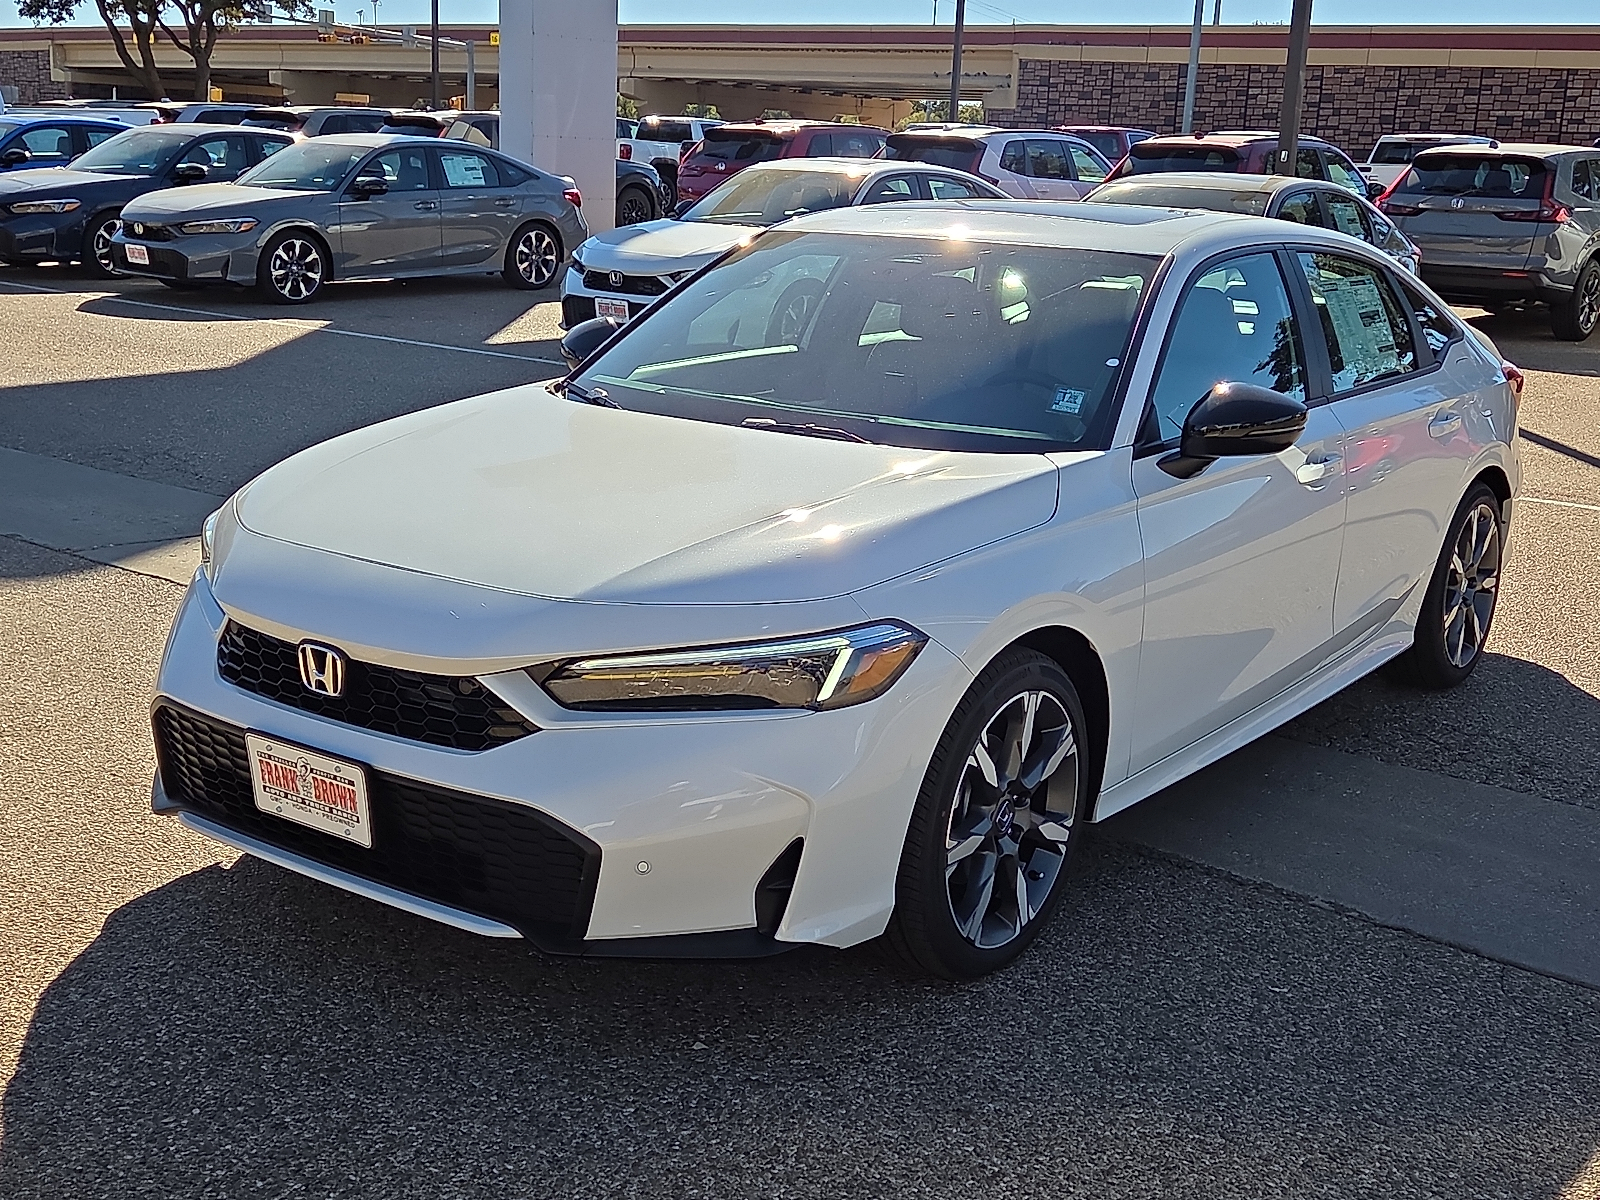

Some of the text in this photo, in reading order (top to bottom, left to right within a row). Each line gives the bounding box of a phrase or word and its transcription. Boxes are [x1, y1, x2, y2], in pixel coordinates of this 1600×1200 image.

[258, 759, 358, 814] FRANK BROWN
[265, 786, 358, 823] AUTO AND TRUCK RANCH
[269, 794, 356, 828] GMC HONDA PREOWNED
